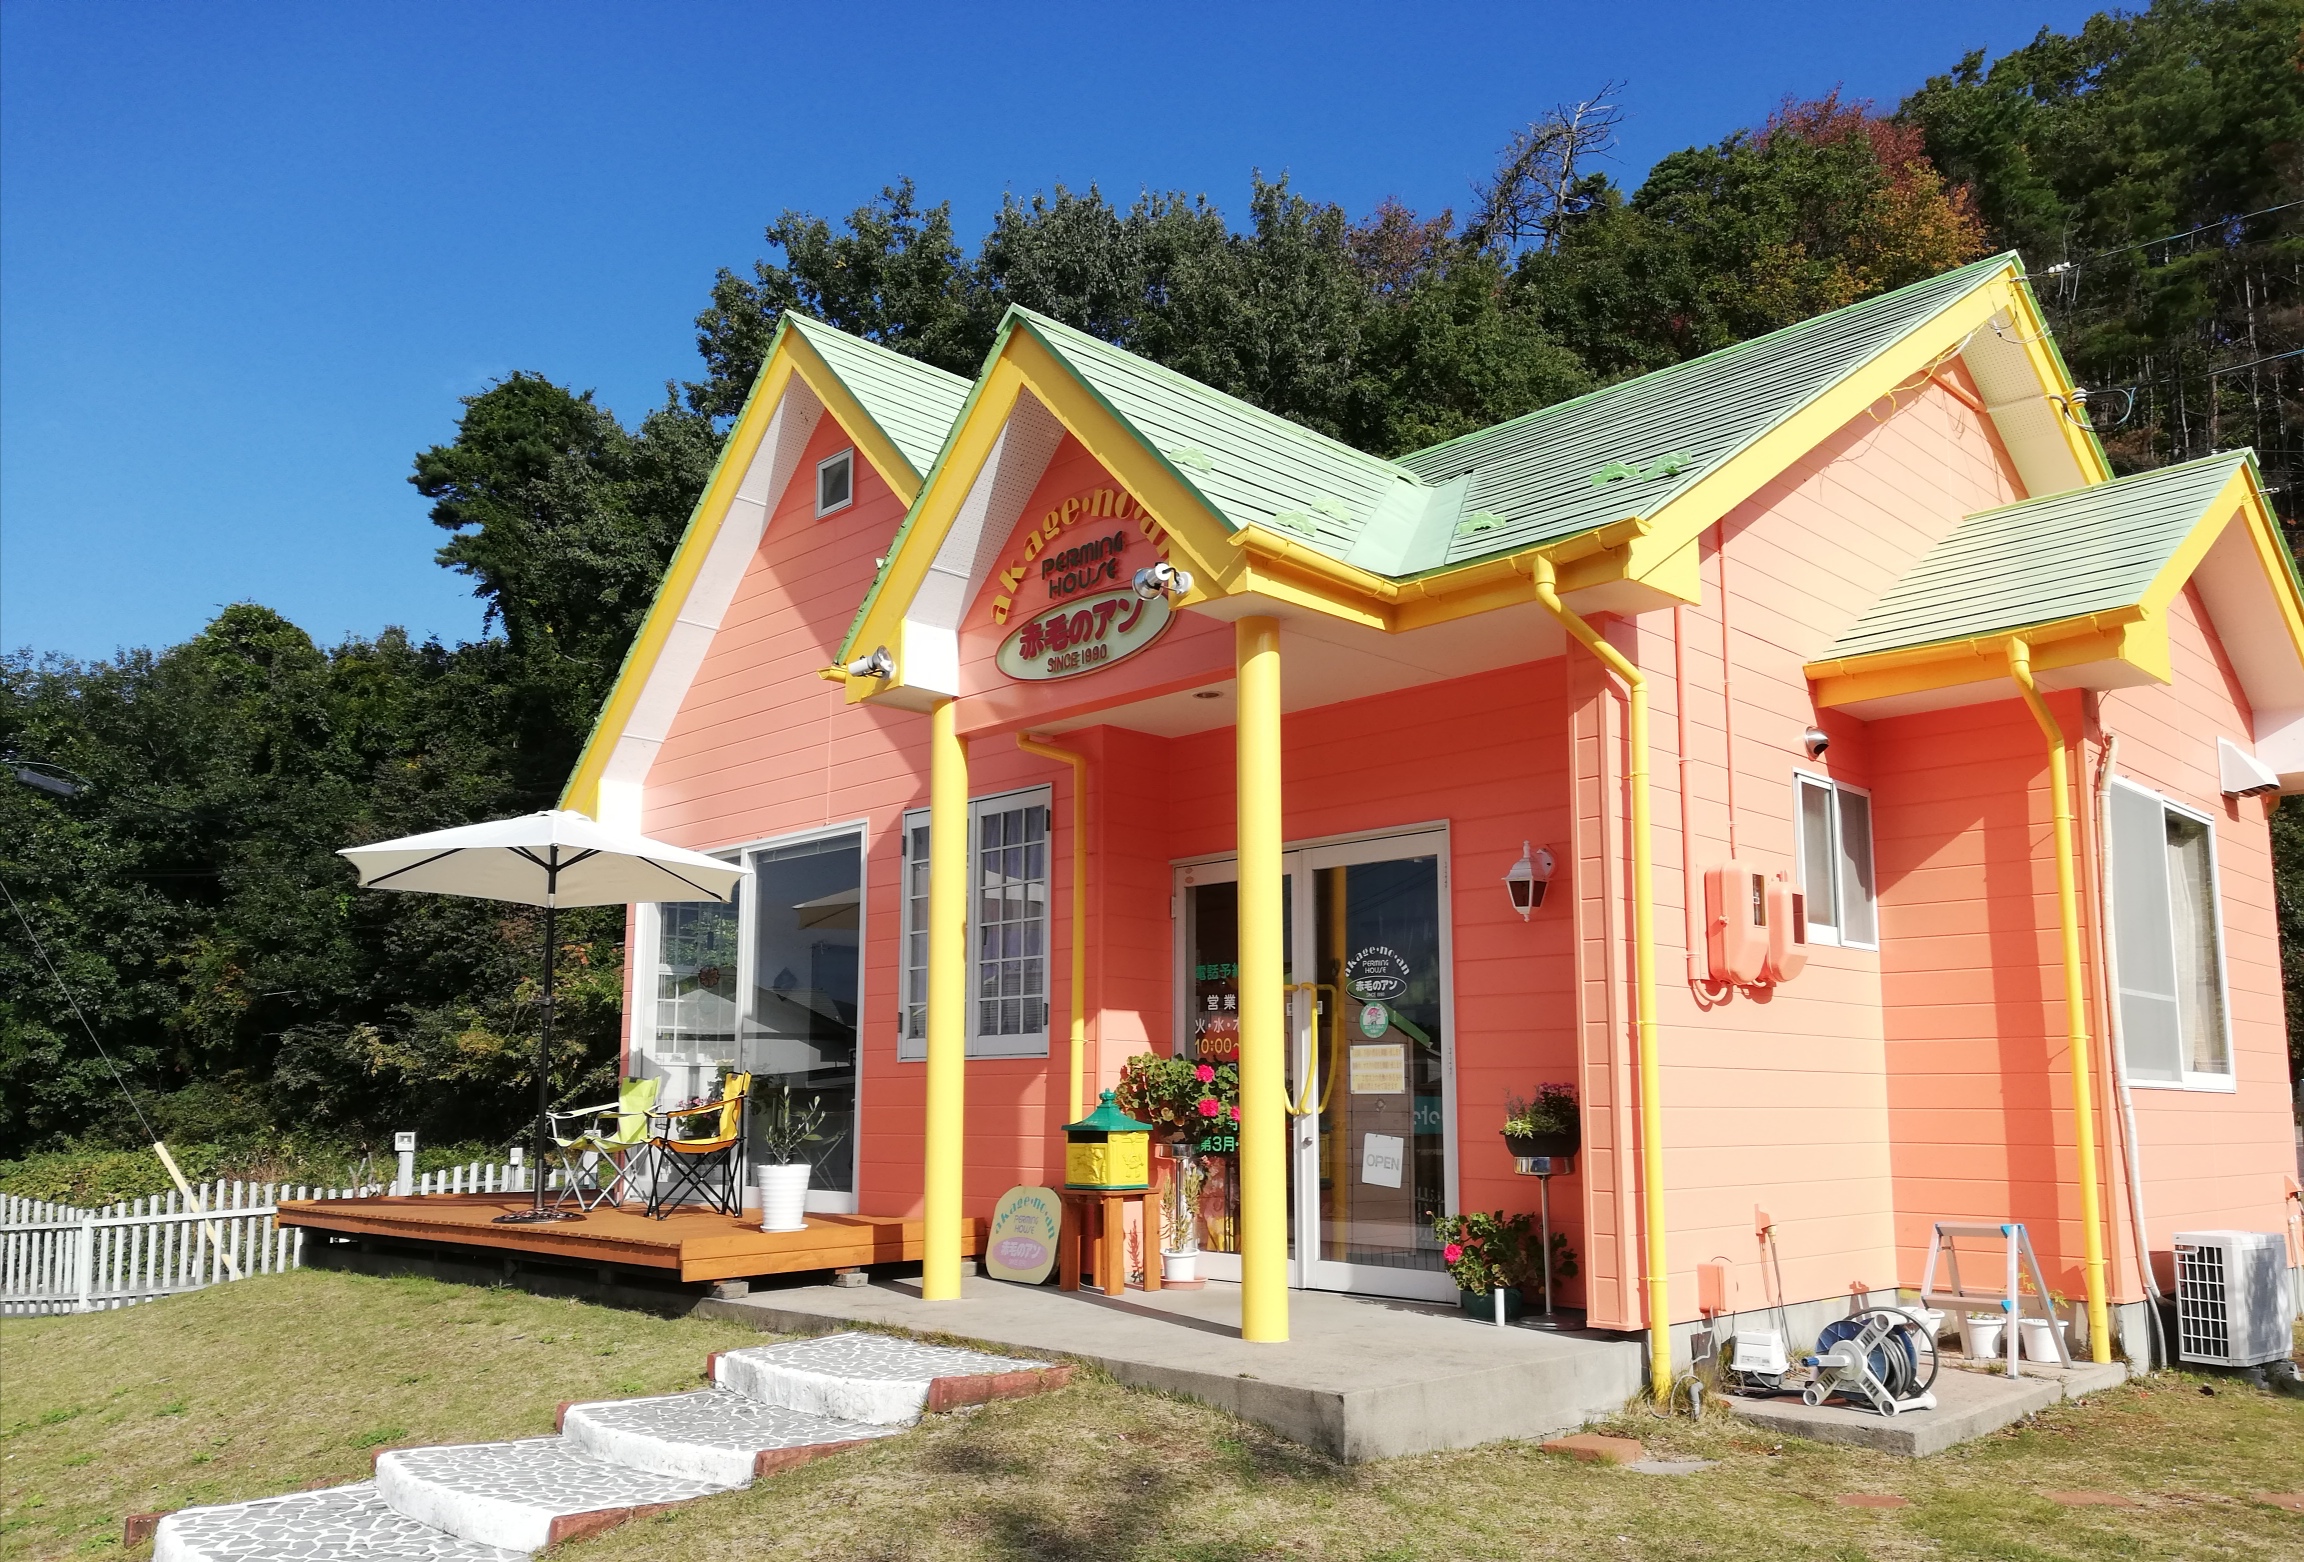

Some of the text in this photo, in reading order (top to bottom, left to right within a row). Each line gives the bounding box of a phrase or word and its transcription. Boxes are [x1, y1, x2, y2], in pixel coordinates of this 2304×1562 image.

[1049, 557, 1118, 599] HOUSE
[1018, 598, 1145, 661] 赤毛のアン
[1046, 643, 1108, 673] SINCE 1990
[1355, 980, 1398, 992] 赤毛のアン
[1366, 1153, 1400, 1171] OPEN
[1001, 1241, 1041, 1258] 赤毛のアン
